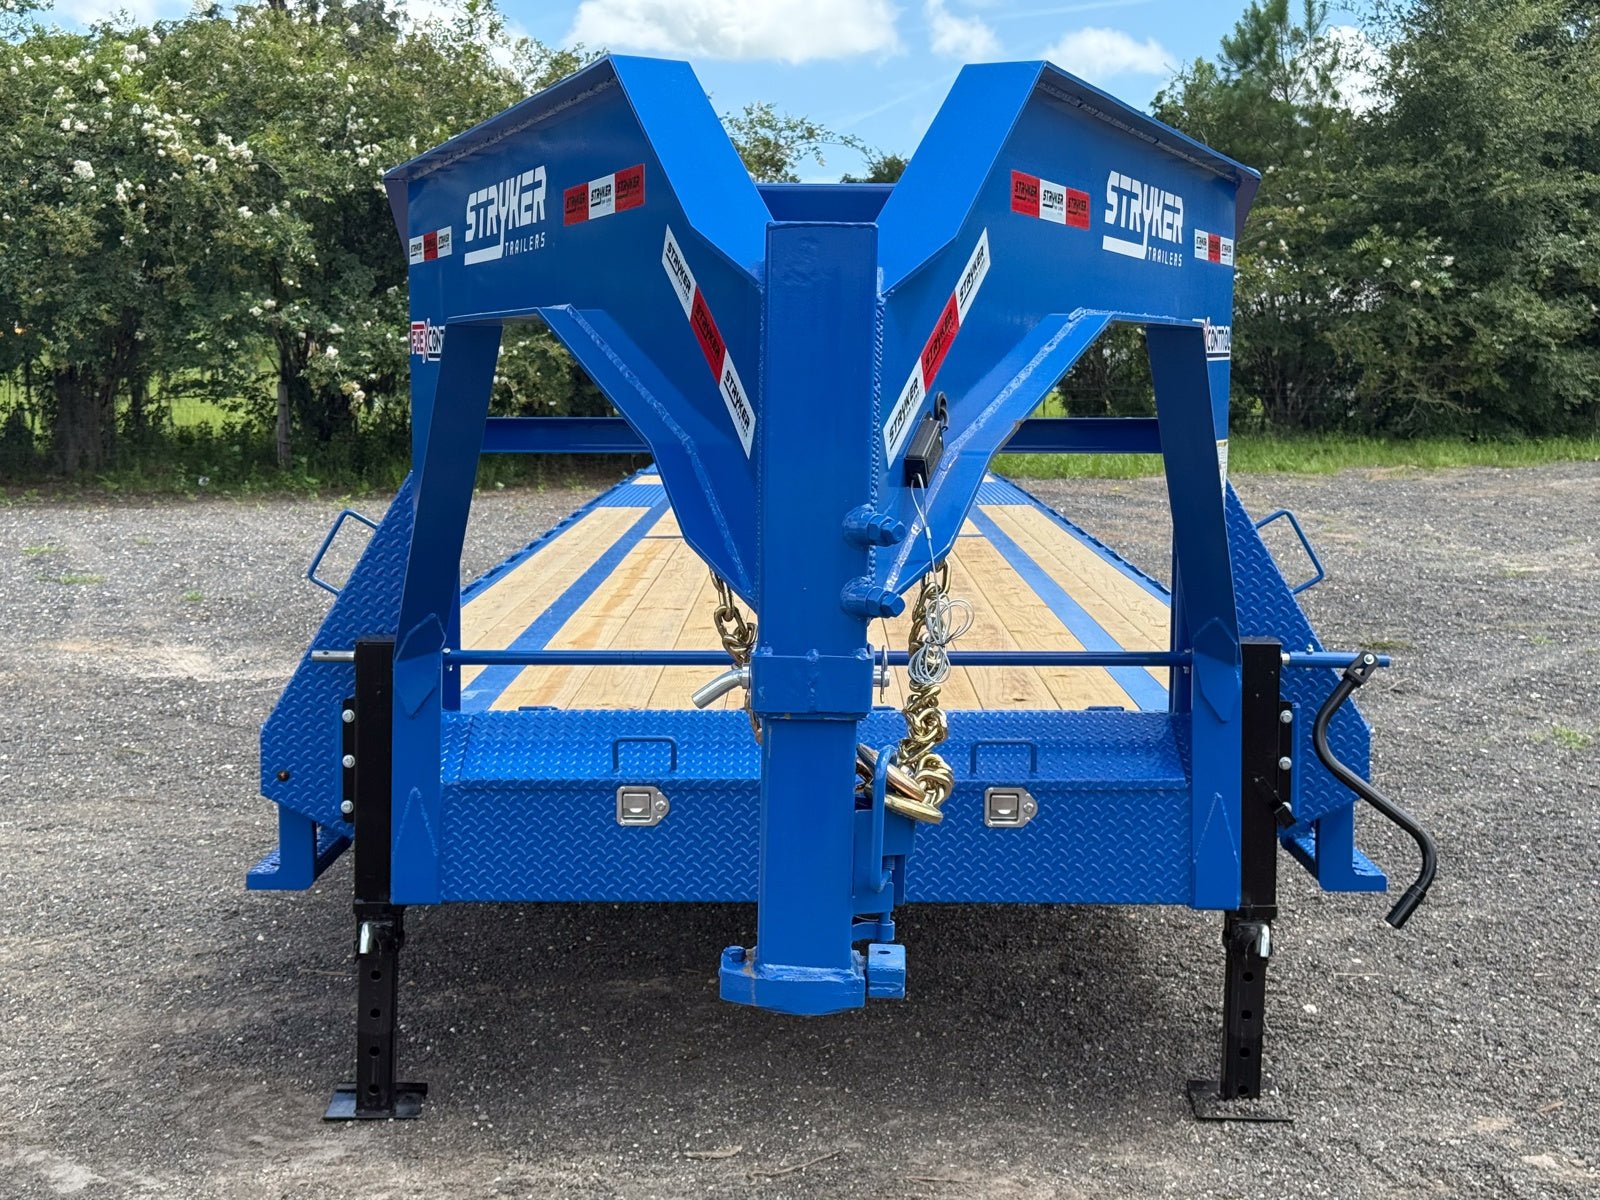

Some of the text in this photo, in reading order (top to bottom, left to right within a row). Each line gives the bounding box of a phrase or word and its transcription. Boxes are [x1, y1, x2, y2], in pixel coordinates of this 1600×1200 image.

[591, 184, 611, 207] STRYKER
[1043, 190, 1064, 209] STRYKER
[464, 165, 547, 265] STRYKER
[1102, 170, 1183, 260] STRYKER
[505, 232, 545, 256] TRAILERS
[1148, 246, 1183, 267] TRAILERS
[428, 326, 445, 353] CONT
[665, 241, 692, 295] STRYKER
[724, 370, 750, 430] STRYKER
[889, 377, 919, 447] STRYKER
[959, 245, 985, 309] STRYKER
